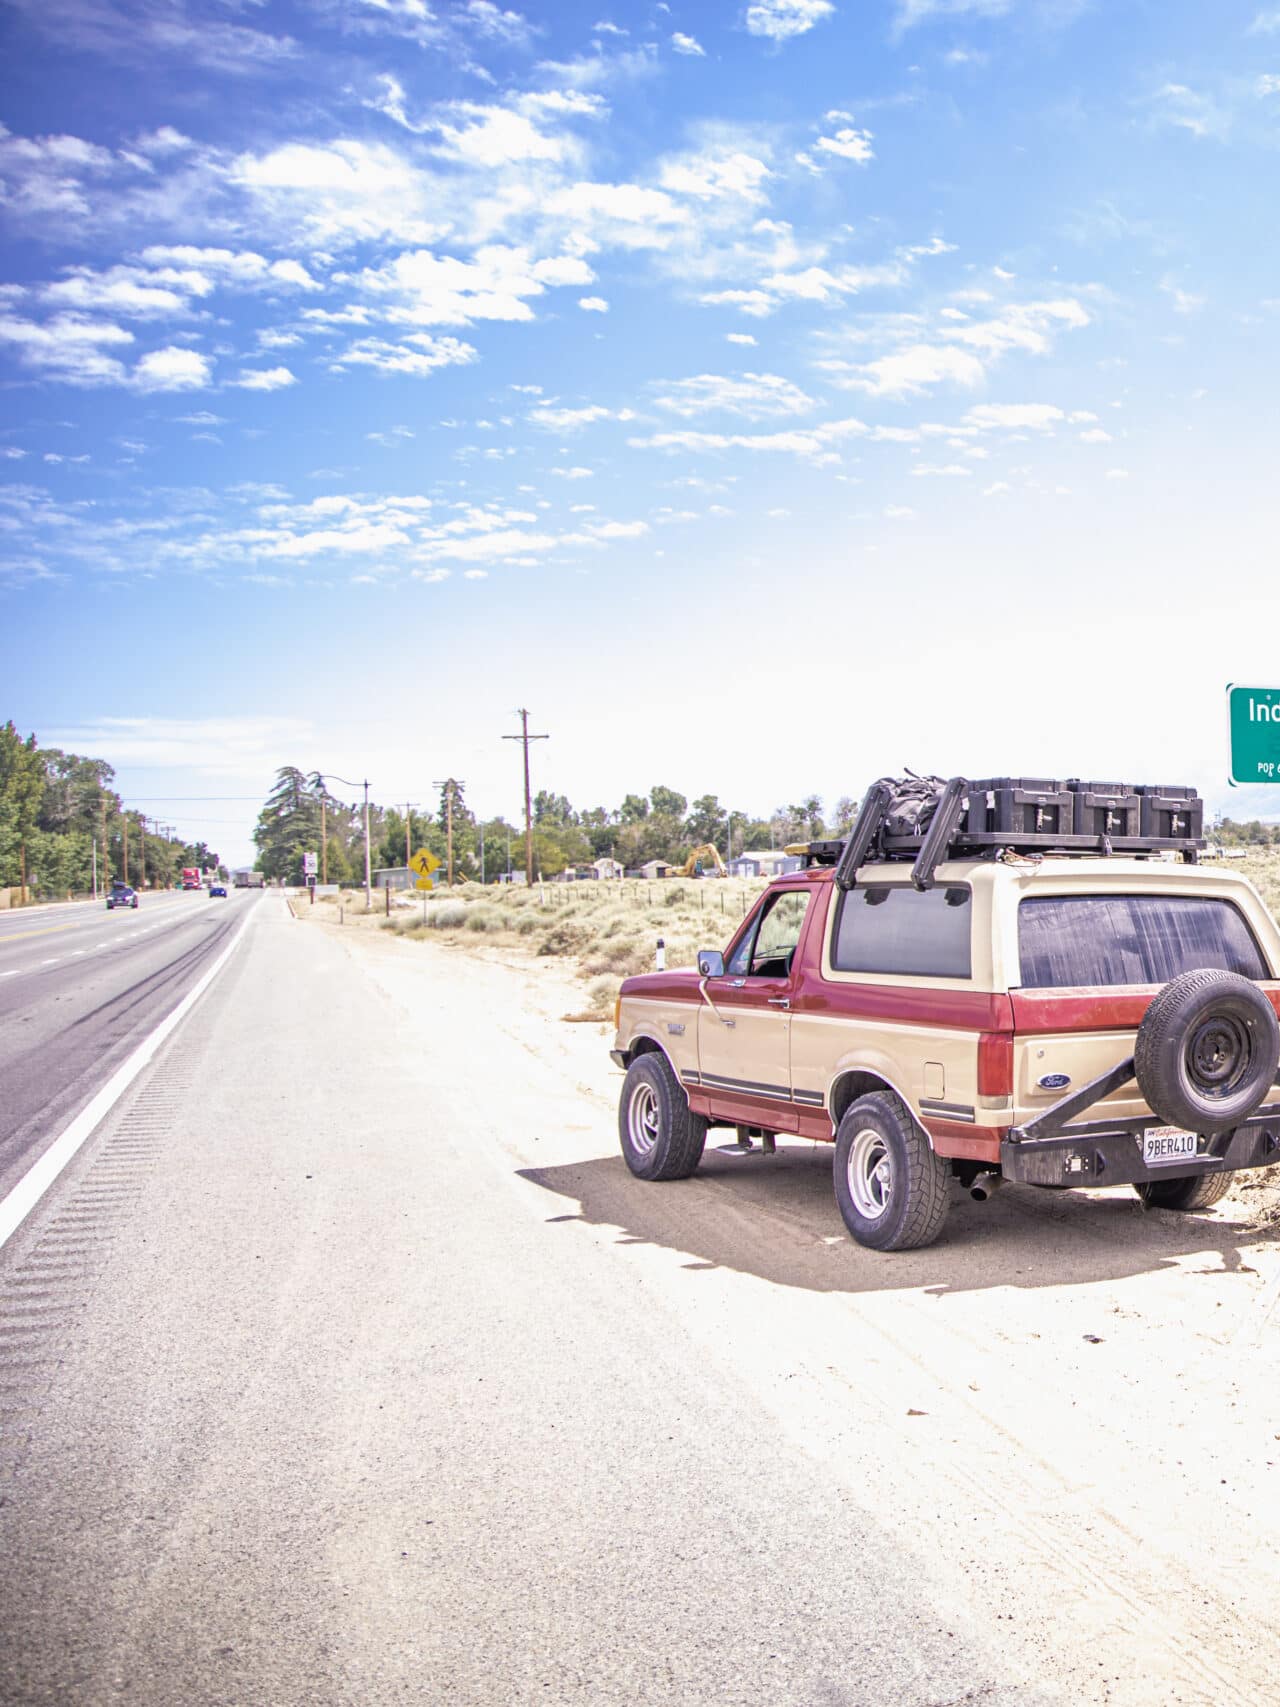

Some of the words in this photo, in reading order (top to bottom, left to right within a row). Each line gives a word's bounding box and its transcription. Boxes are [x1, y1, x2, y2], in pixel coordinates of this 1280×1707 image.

[1257, 762, 1275, 774] POP
[1044, 1075, 1065, 1087] Ford
[1147, 1136, 1194, 1157] 9BER410
